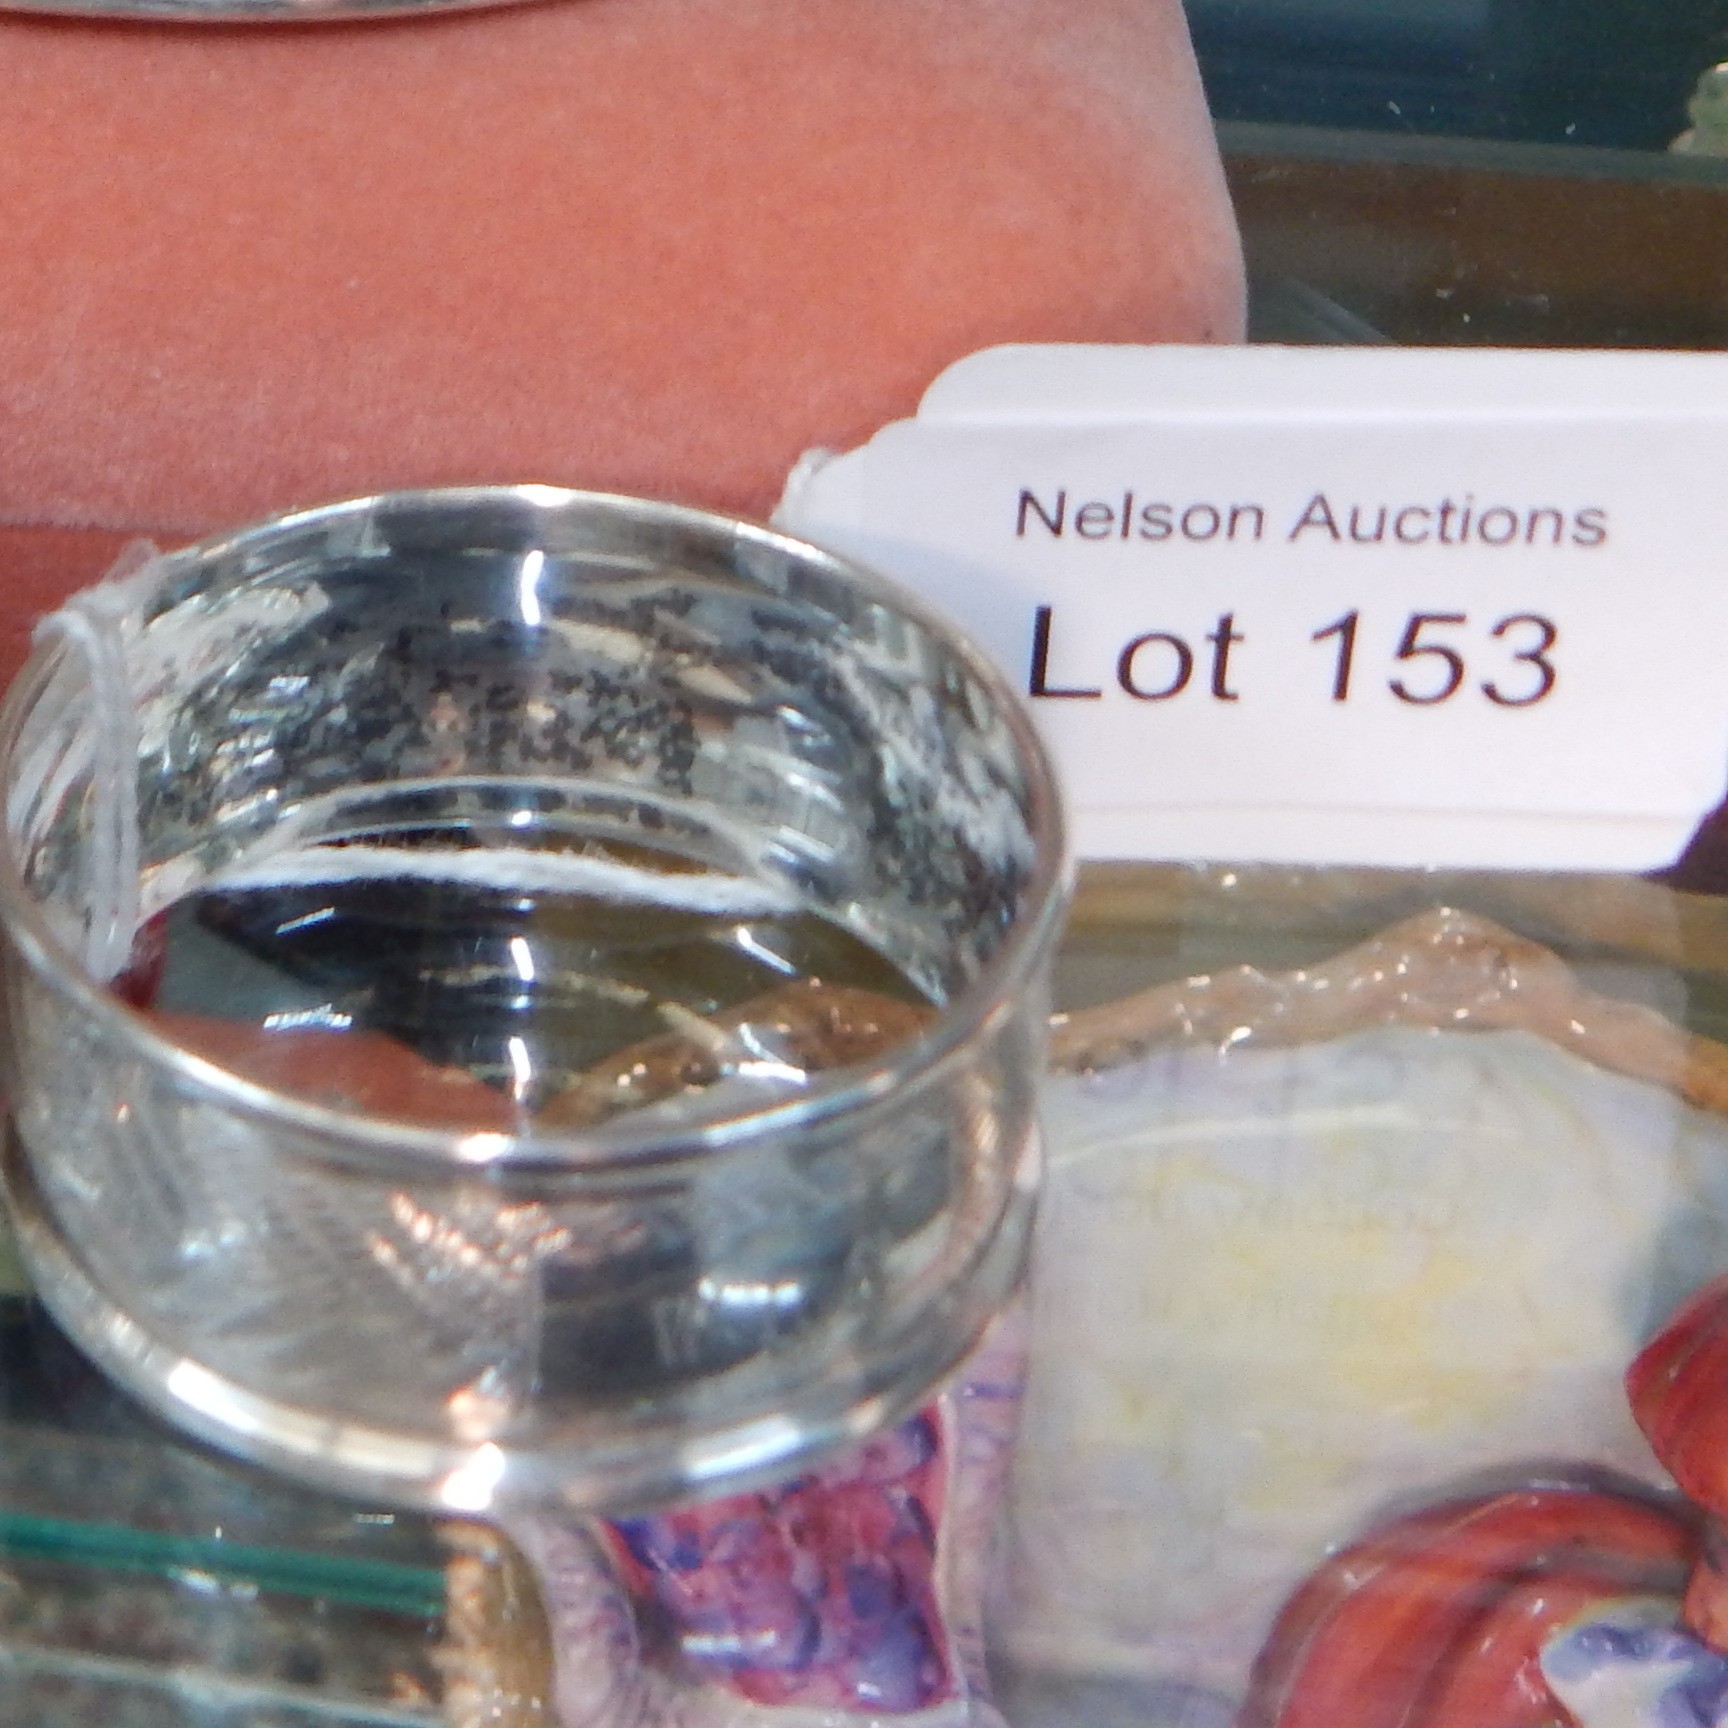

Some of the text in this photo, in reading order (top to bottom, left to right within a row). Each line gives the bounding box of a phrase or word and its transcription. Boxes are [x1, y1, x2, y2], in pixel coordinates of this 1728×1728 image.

[1013, 486, 1610, 549] Nelson Auctions
[1027, 604, 1561, 709] Lot 153
